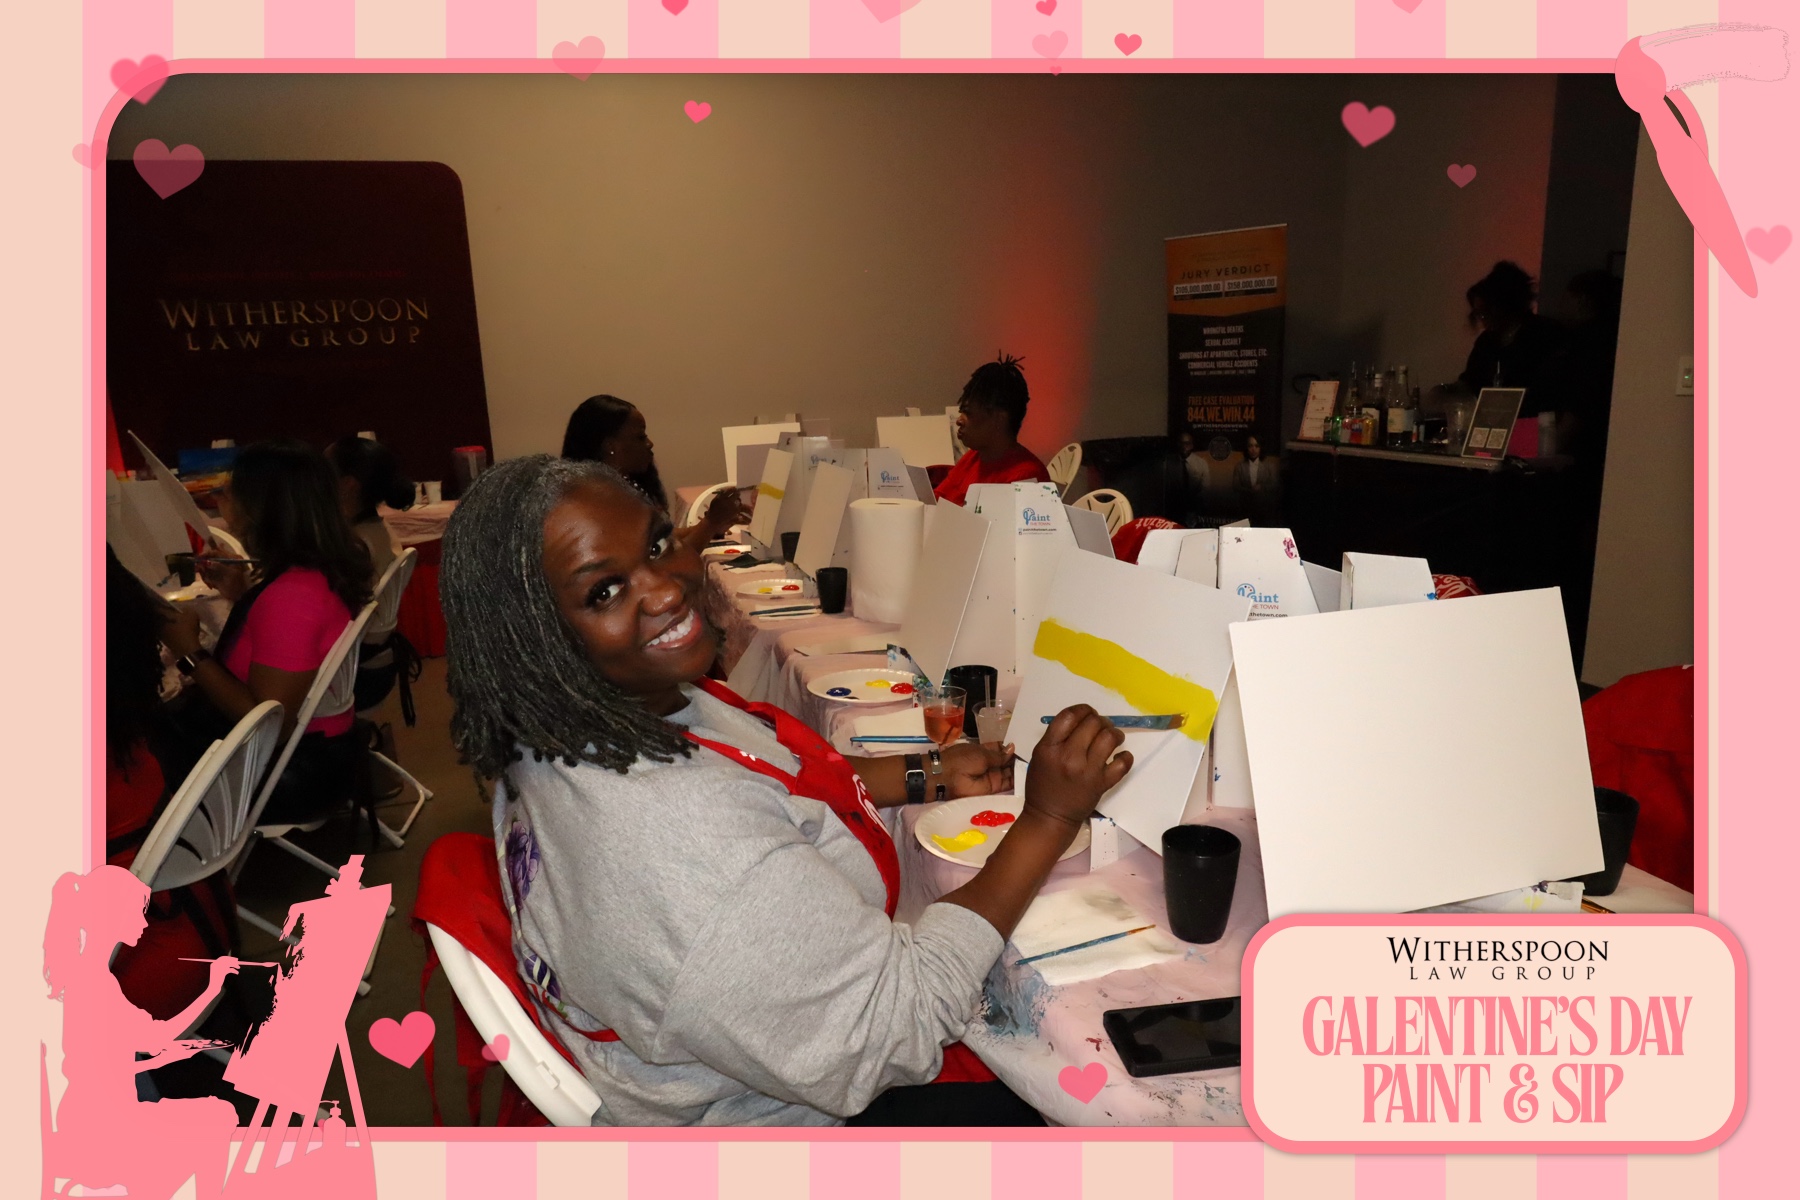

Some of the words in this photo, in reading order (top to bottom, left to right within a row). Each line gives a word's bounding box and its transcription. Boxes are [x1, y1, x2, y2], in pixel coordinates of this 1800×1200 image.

[1182, 269, 1210, 280] JURY
[1216, 263, 1270, 277] VERDICT
[159, 297, 430, 329] WITHERSPOON
[1227, 325, 1244, 334] DEATHS
[187, 331, 262, 351] LAW
[290, 326, 420, 348] GROUP
[1205, 338, 1221, 347] SEXUAL
[1222, 337, 1241, 346] ASSAULT
[1179, 351, 1203, 360] SHOOTINGS
[1203, 351, 1209, 359] AT
[1187, 361, 1215, 369] COMMERCIAL
[1216, 360, 1233, 368] VEHICLE
[1234, 359, 1258, 368] ACCIDENTS
[1188, 395, 1203, 405] FREE
[1203, 395, 1218, 405] CASE
[1219, 394, 1255, 405] EVALUATION
[1023, 507, 1051, 525] Paint
